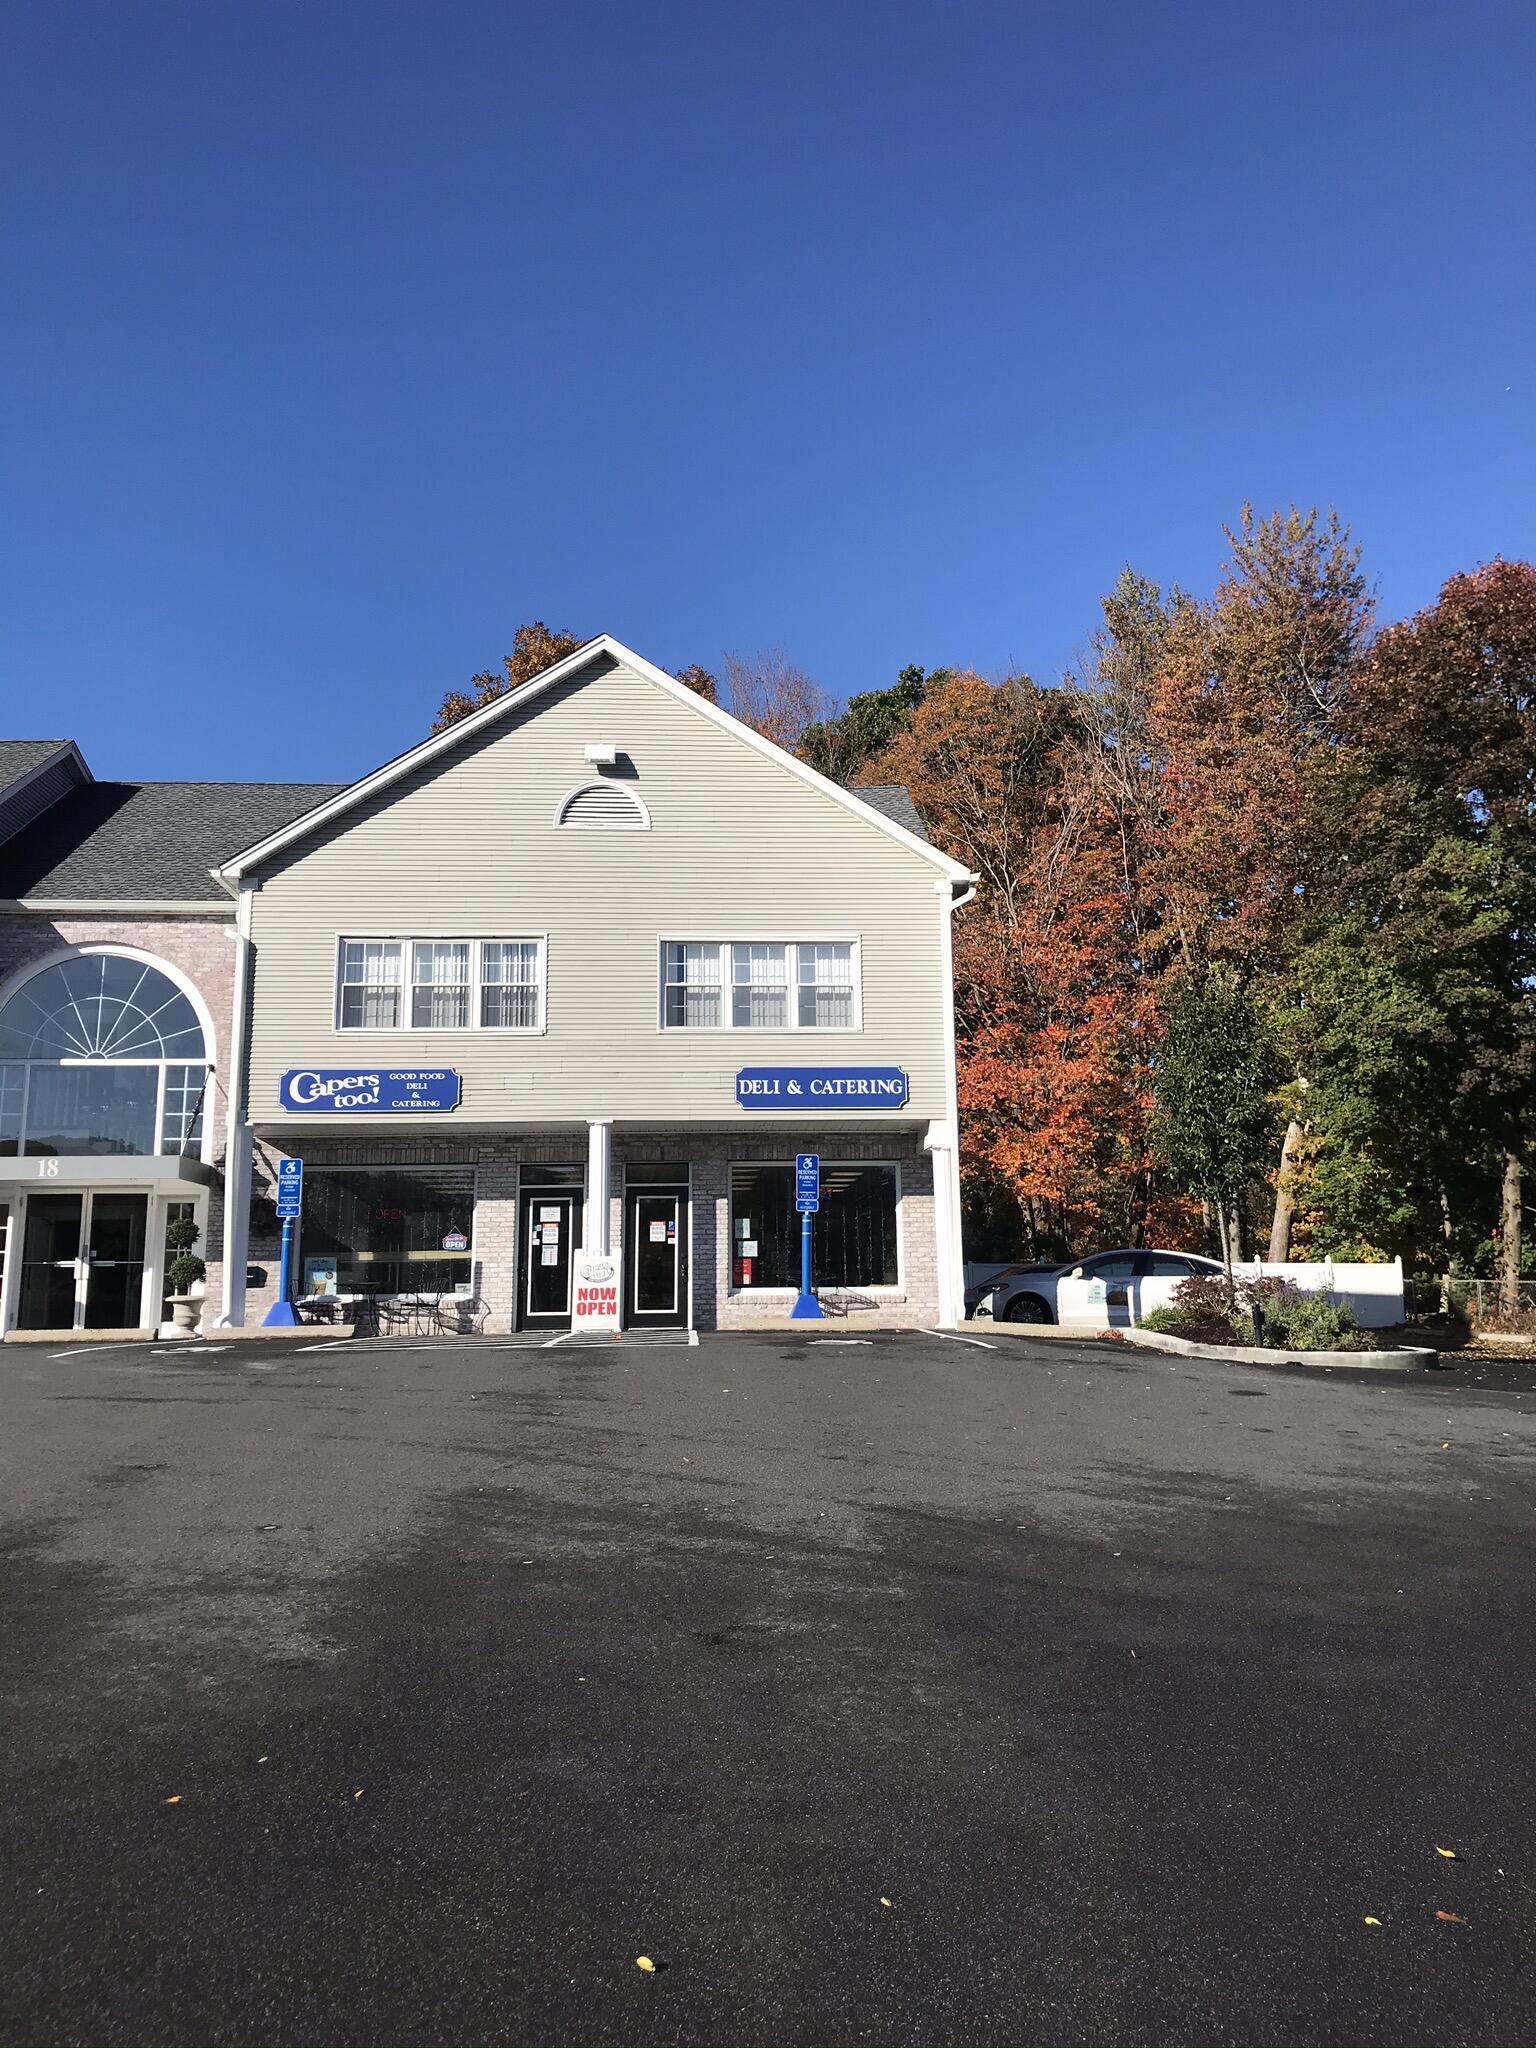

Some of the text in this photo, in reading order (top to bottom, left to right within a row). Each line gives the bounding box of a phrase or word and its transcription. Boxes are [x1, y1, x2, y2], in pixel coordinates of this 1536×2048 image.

[289, 1072, 379, 1103] Capers
[739, 1080, 903, 1095] DELI & CATERING
[334, 1087, 379, 1108] too!
[37, 1158, 58, 1177] 18
[578, 1287, 616, 1301] NOW
[576, 1302, 617, 1315] OPEN
